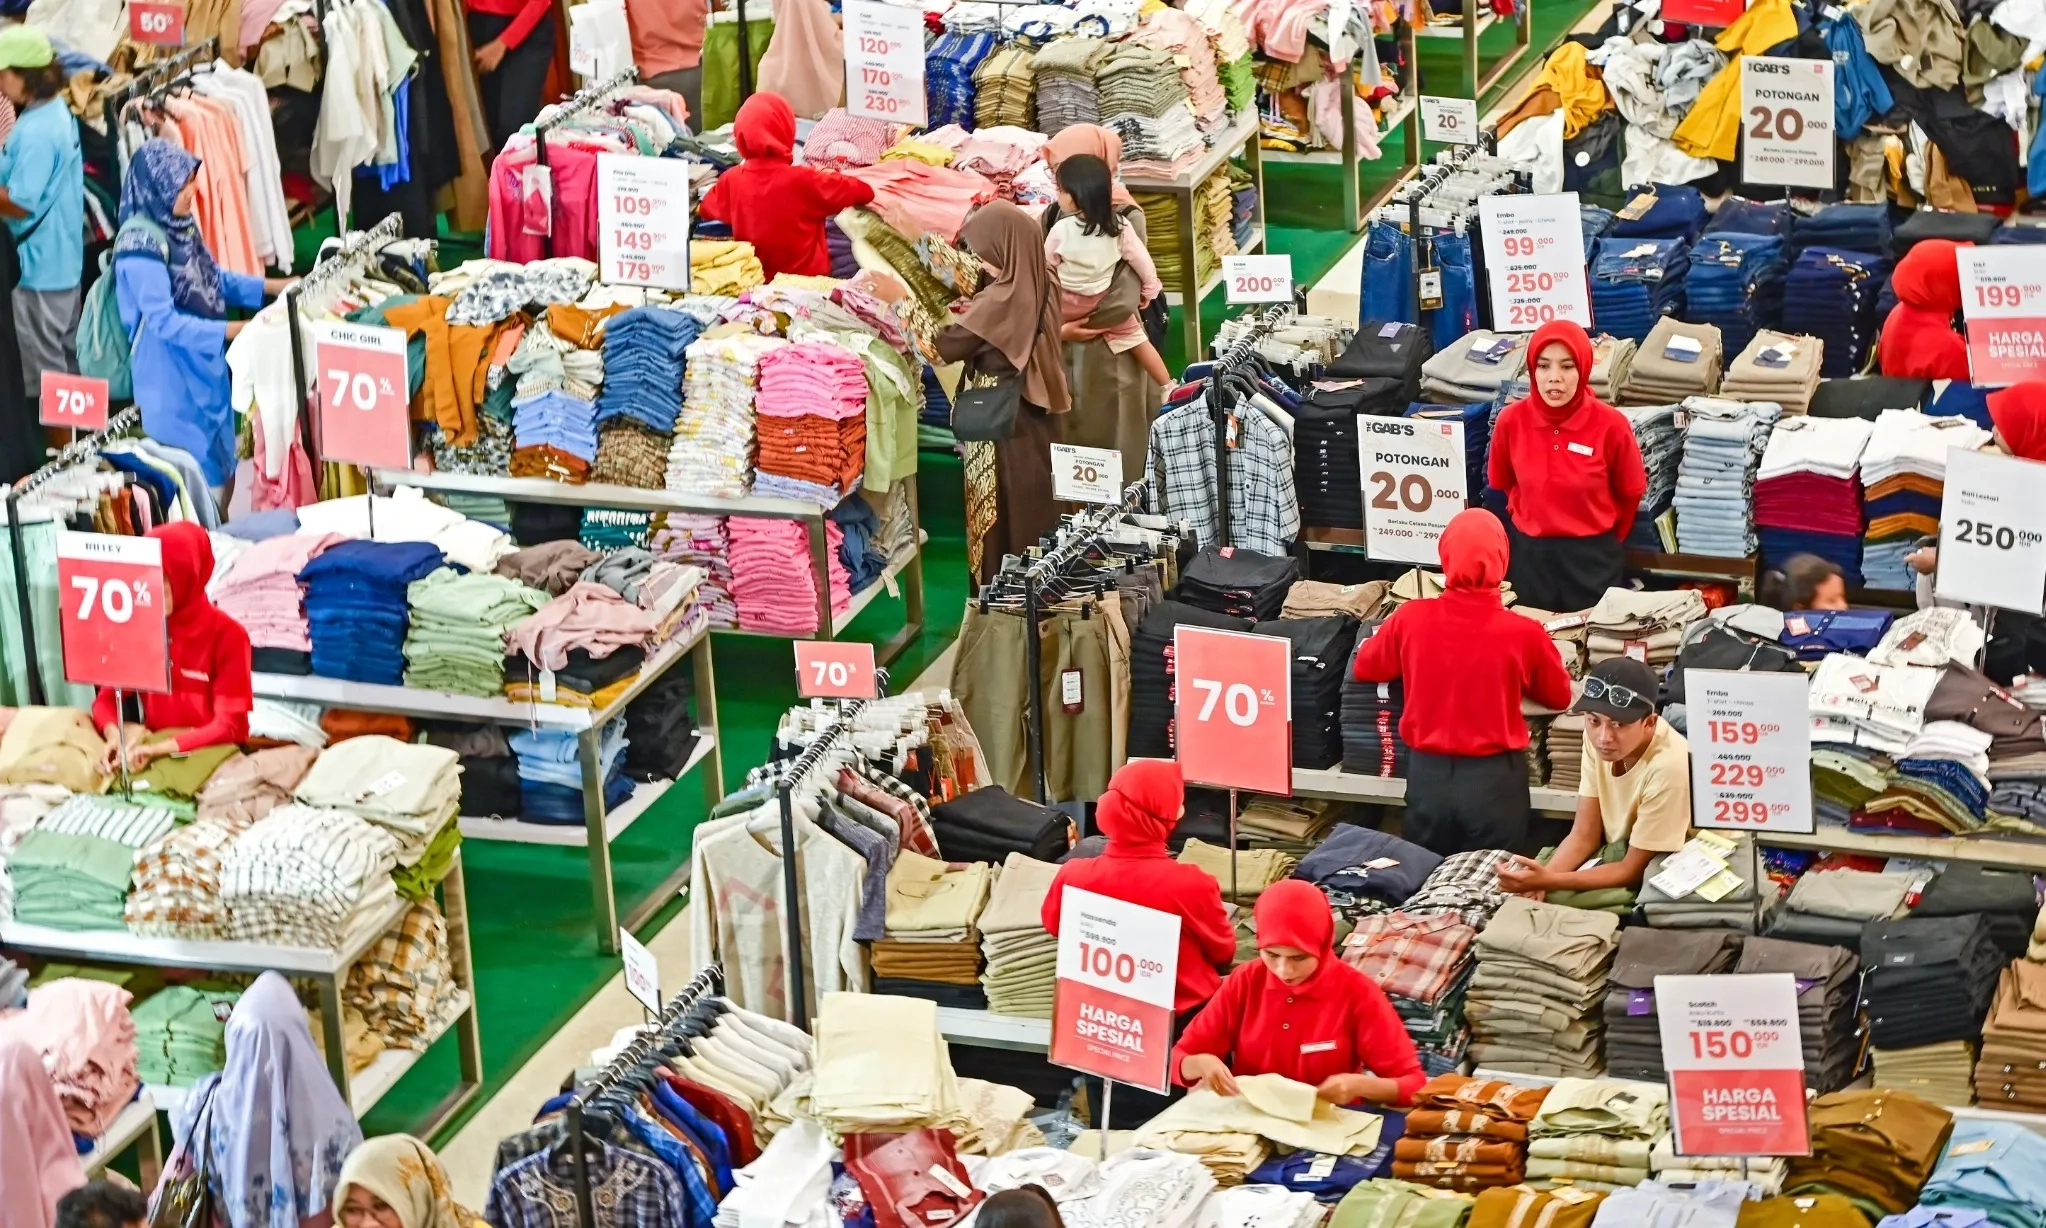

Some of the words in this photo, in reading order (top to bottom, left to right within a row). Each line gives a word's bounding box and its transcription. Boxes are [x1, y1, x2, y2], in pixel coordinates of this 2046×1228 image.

[1755, 89, 1819, 102] POTONGAN
[330, 329, 357, 342] CHIC
[360, 333, 383, 346] GIRL
[1988, 331, 2045, 345] HARGA
[1372, 422, 1414, 436] GAB'S
[1375, 452, 1450, 468] POTONGAN
[1378, 528, 1413, 538] 249.000
[1080, 1002, 1144, 1035] HARGA
[1076, 1018, 1144, 1052] SPESIAL
[1702, 1088, 1776, 1104] HARGA
[1702, 1104, 1782, 1121] SPESIAL
